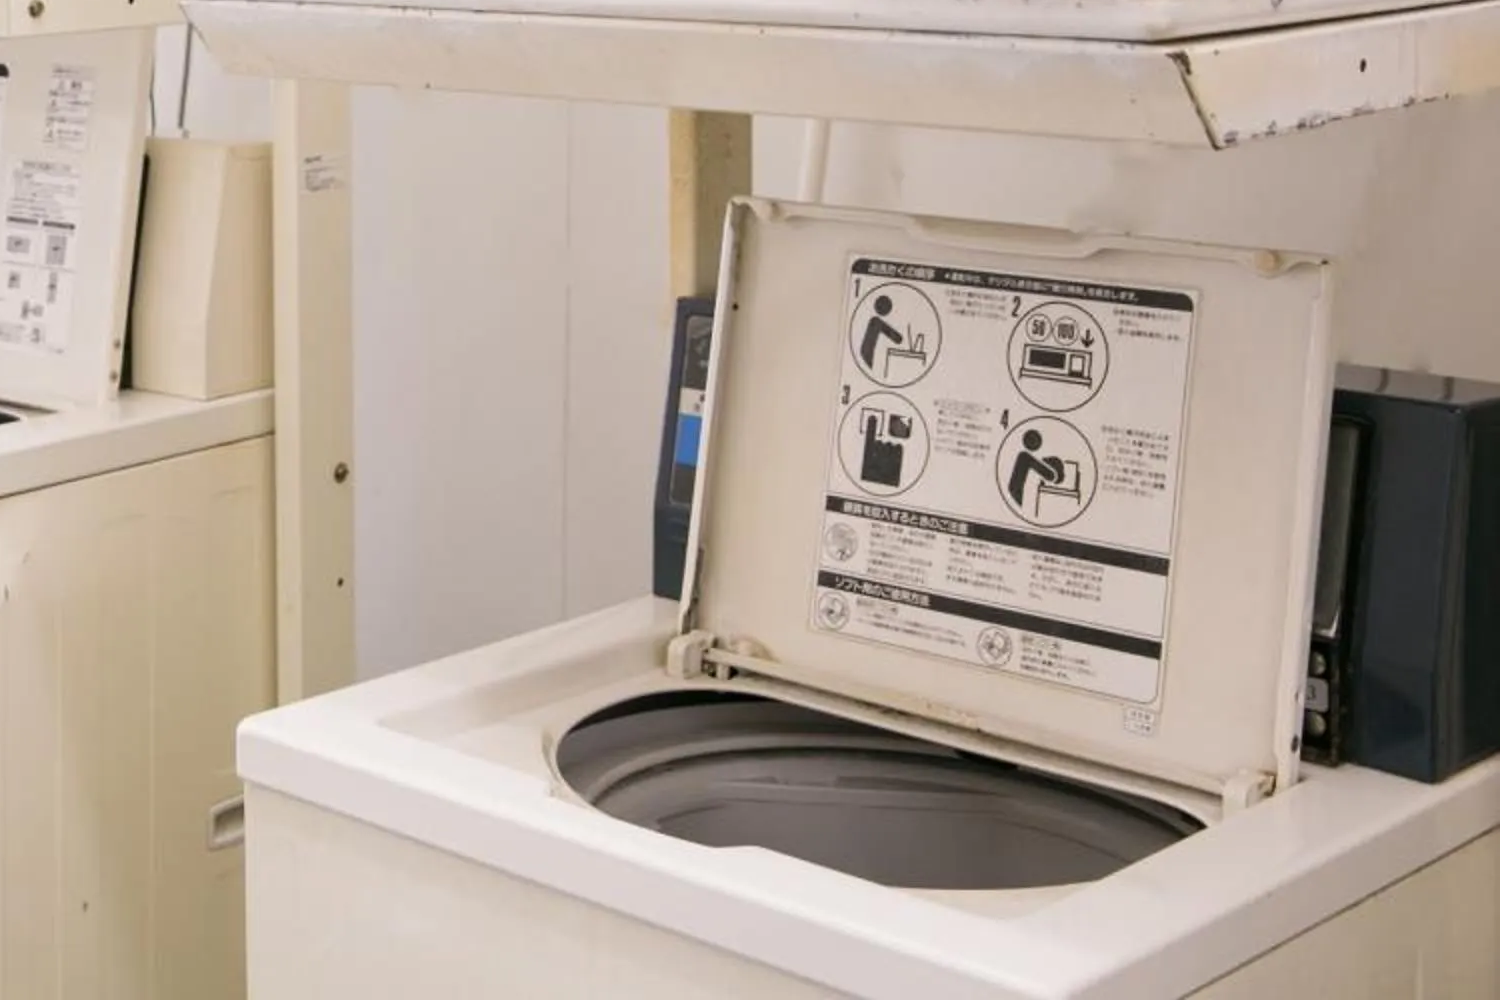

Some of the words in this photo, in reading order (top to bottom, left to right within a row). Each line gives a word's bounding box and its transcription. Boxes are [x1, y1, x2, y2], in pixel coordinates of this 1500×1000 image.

[853, 279, 861, 299] 1
[1011, 295, 1021, 318] 2
[842, 384, 852, 405] 3
[999, 409, 1010, 431] 4
